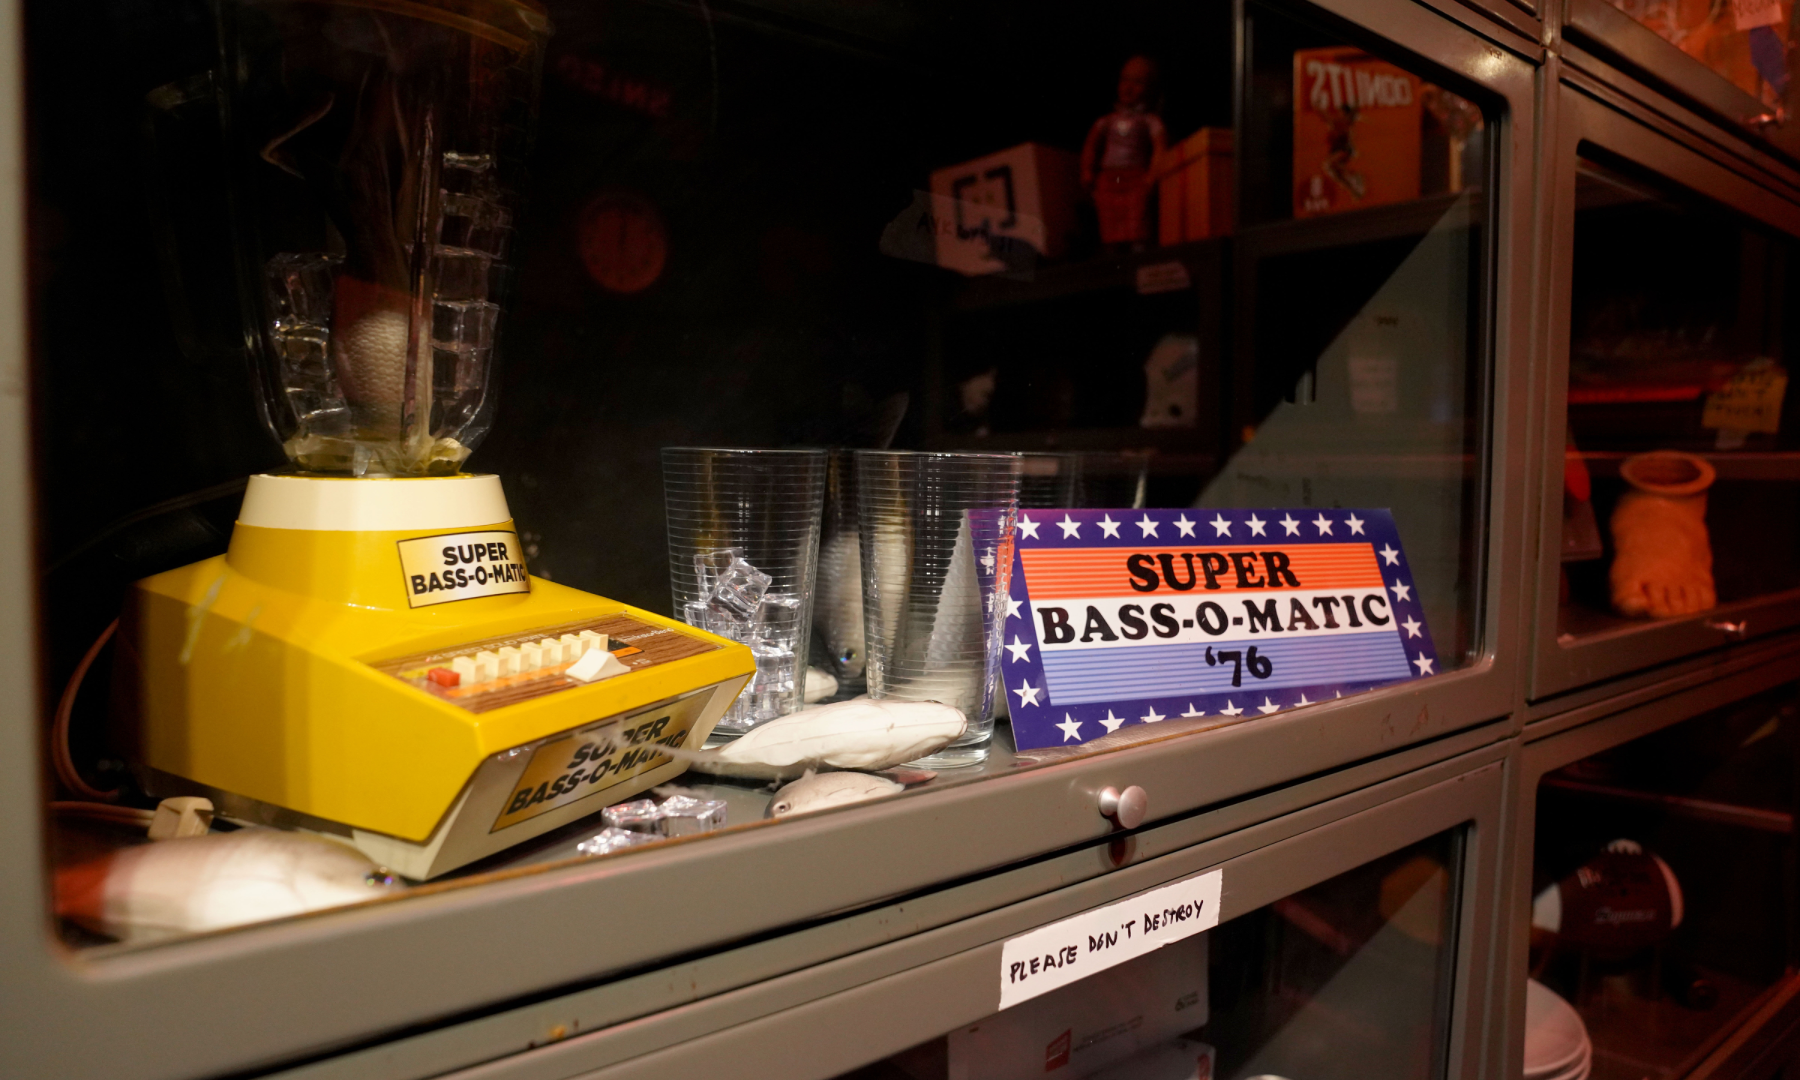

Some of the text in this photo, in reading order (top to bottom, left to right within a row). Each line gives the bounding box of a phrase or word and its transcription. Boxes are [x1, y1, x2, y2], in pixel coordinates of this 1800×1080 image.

[442, 542, 509, 566] SUPER
[1127, 551, 1301, 592] SUPER
[411, 563, 526, 595] BASS-O-MATIC
[1037, 594, 1391, 644] BASS-O-MATIC
[1010, 899, 1204, 984] PLEASE DON'T DESTROY
